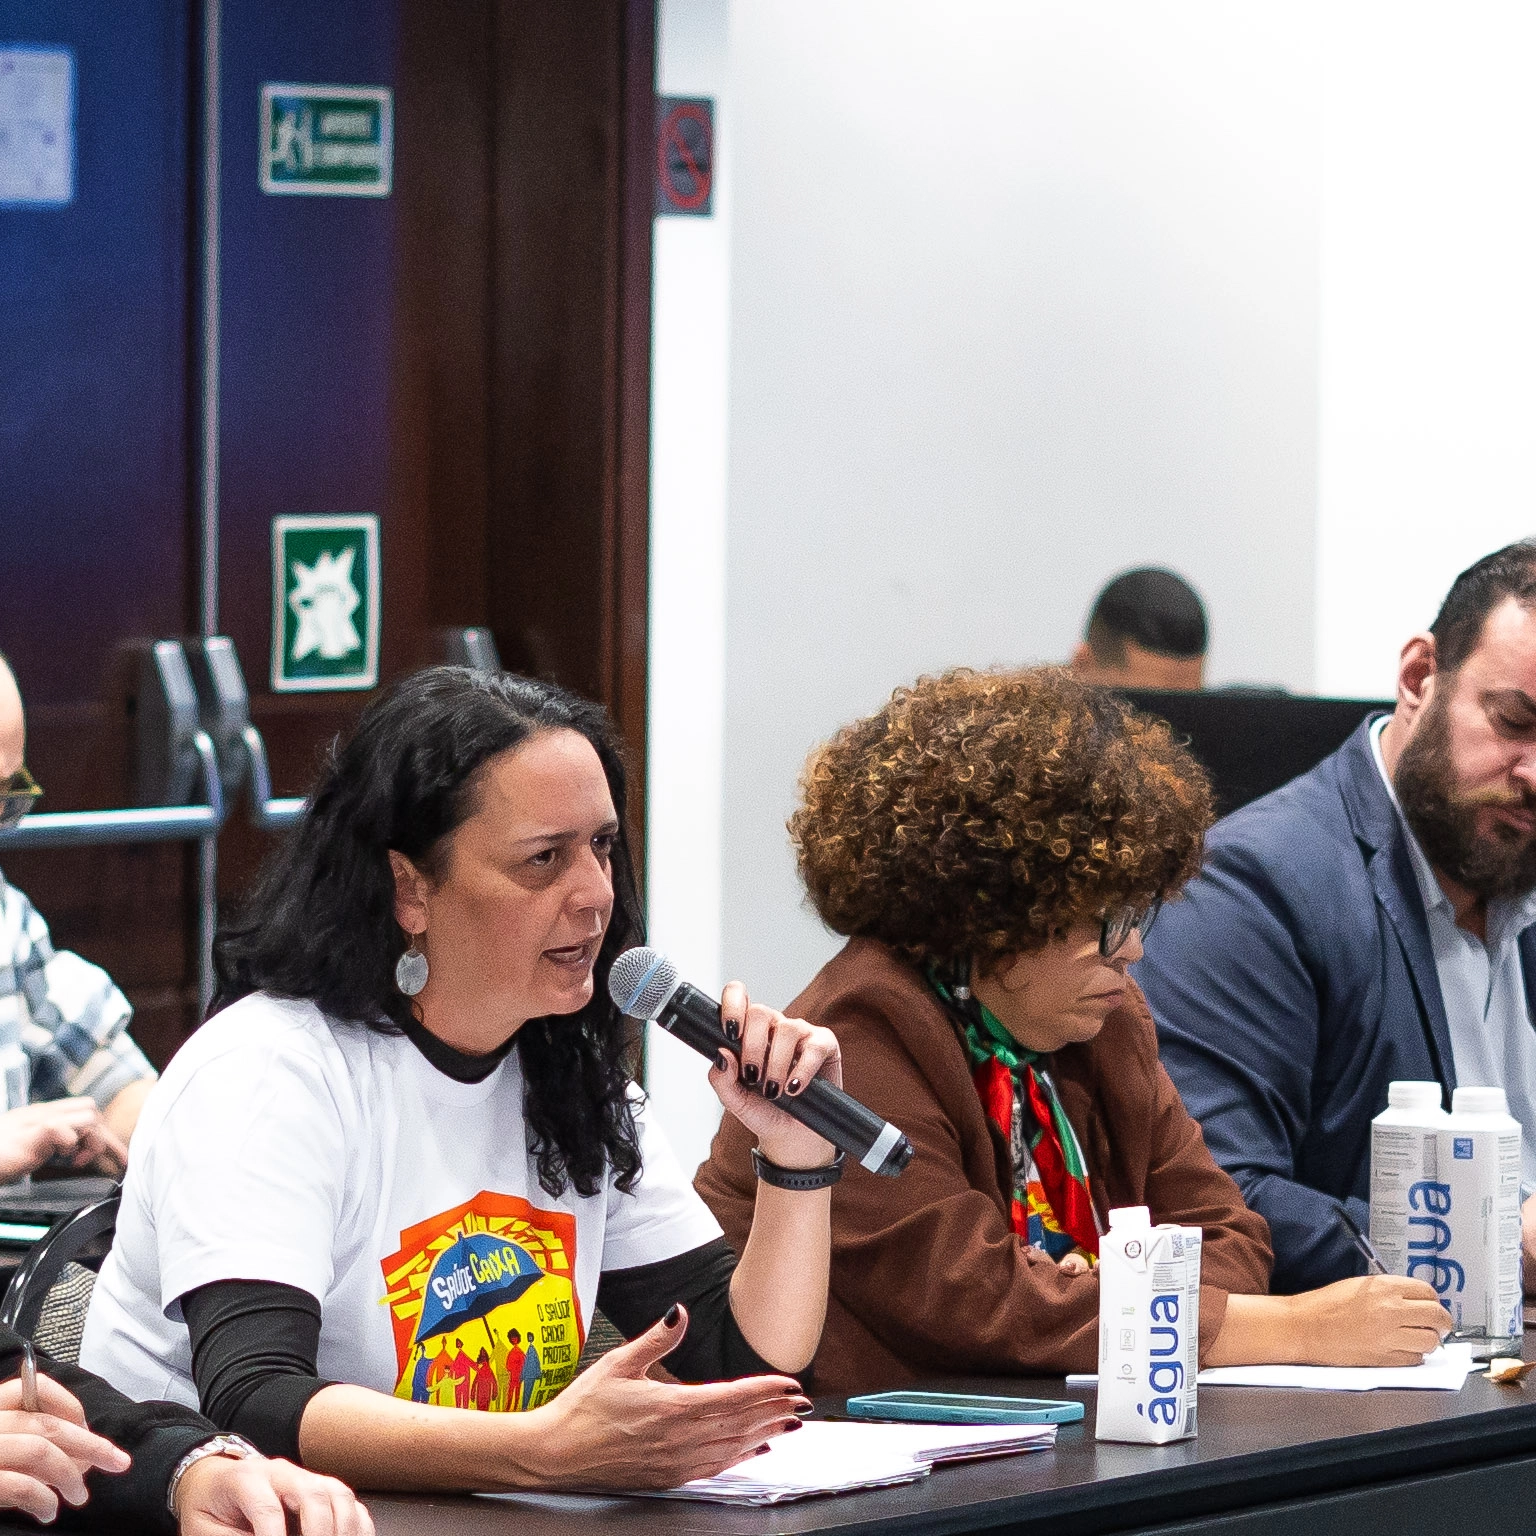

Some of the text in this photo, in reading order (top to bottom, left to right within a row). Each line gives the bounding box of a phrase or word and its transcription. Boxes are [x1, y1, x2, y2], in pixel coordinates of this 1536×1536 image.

[431, 1246, 522, 1311] SAÚDE CAIXA
[1407, 1180, 1465, 1315] gua
[537, 1304, 545, 1322] O
[541, 1324, 566, 1344] CAIXA
[1136, 1294, 1184, 1426] água
